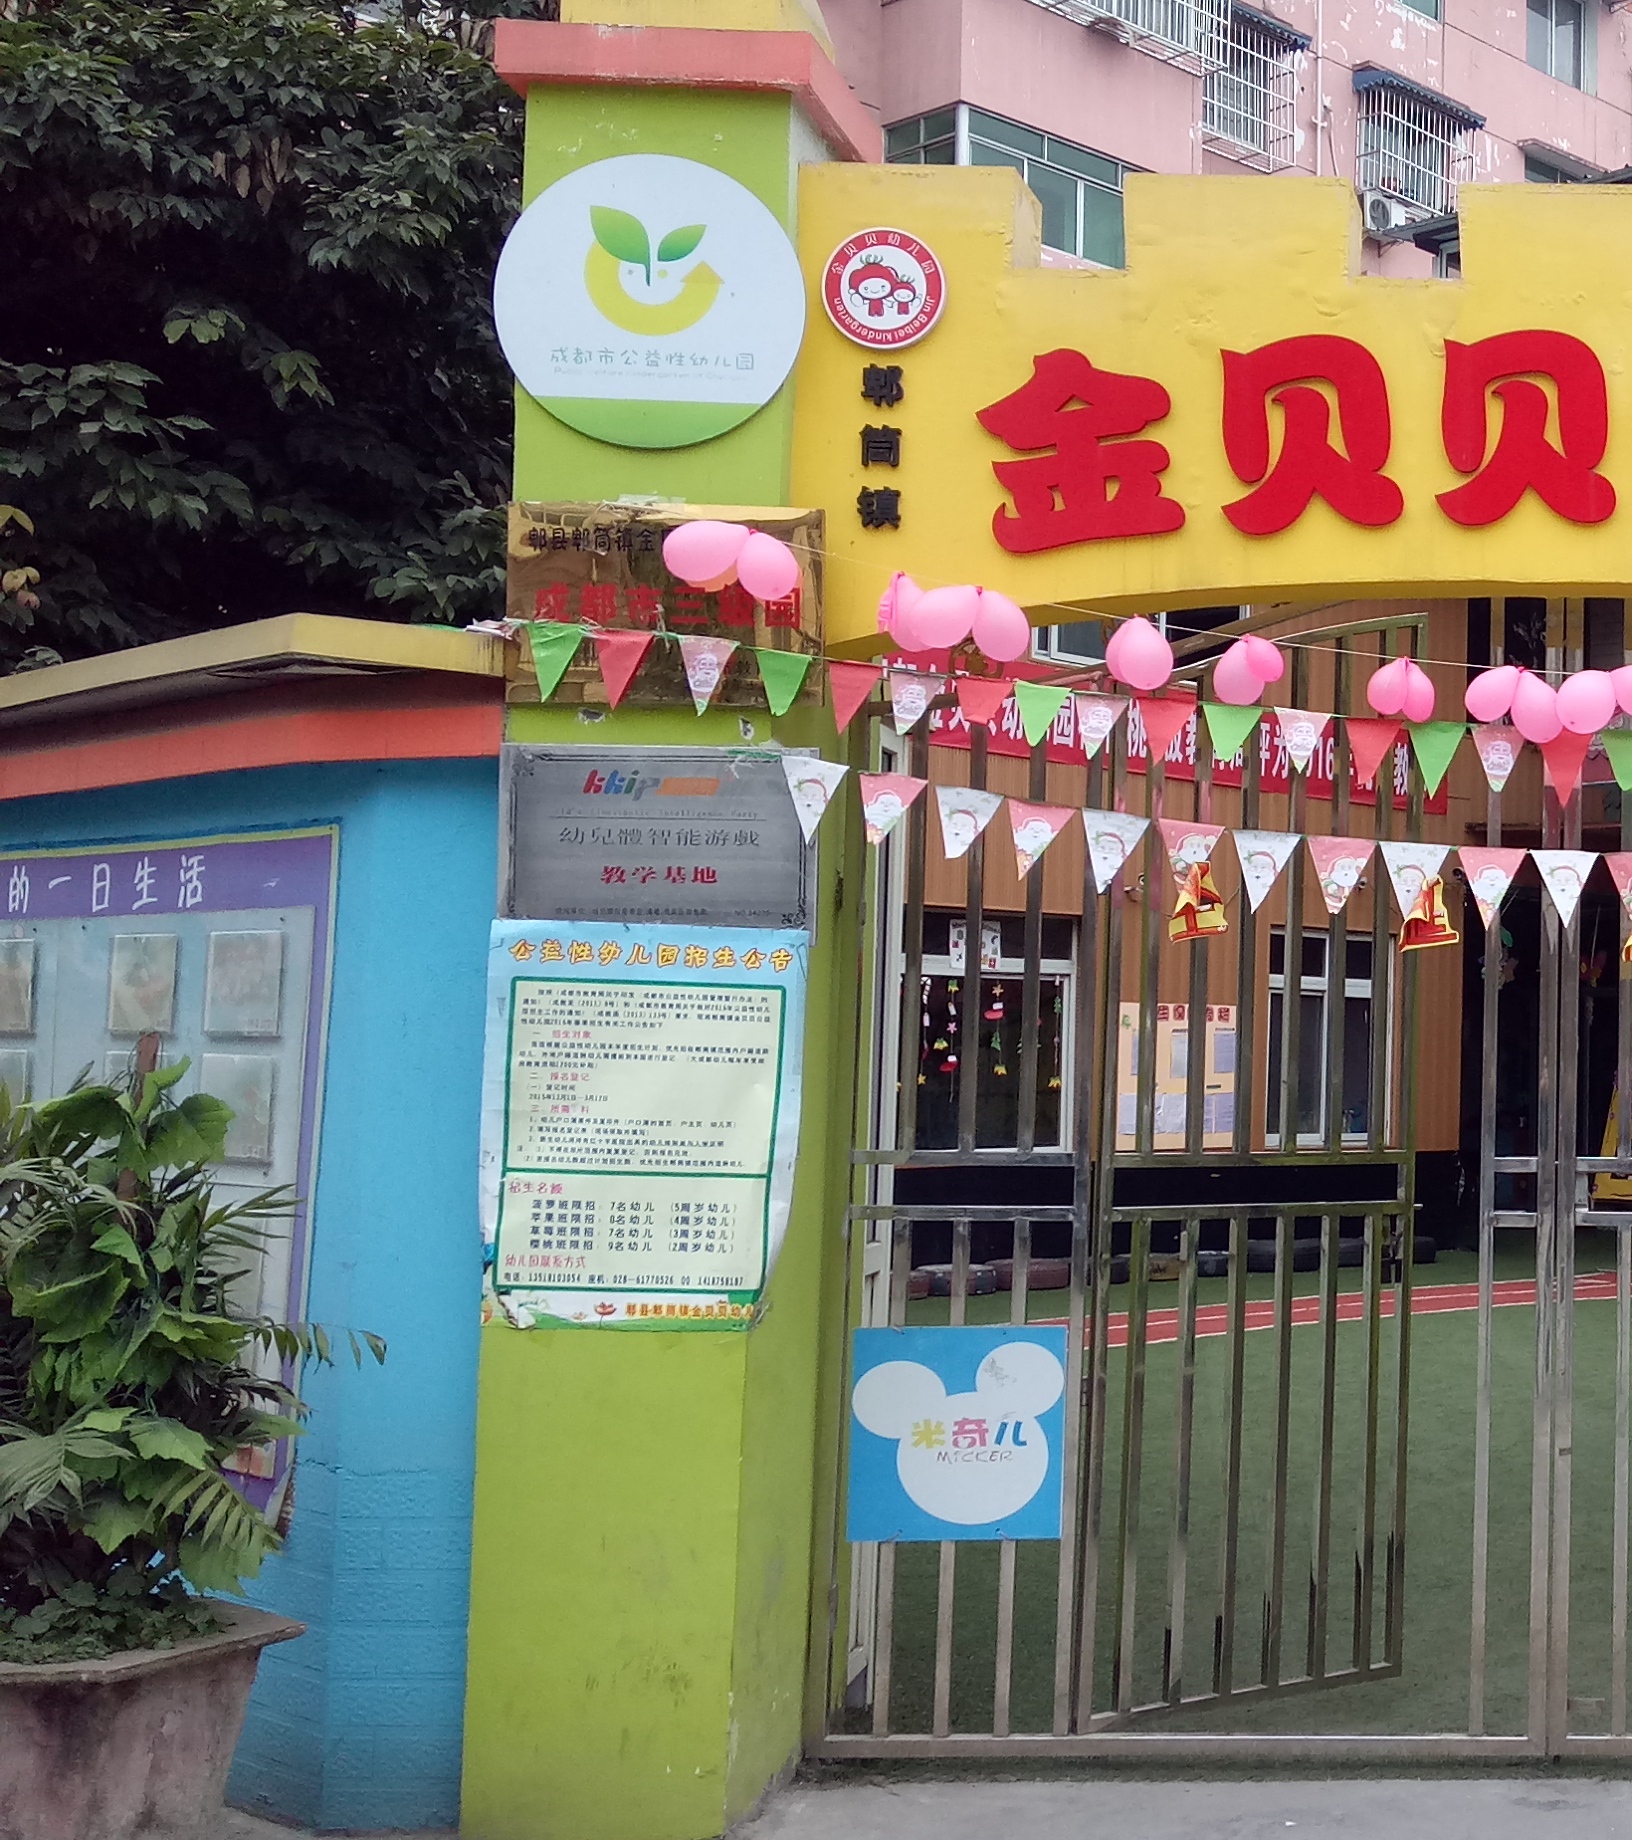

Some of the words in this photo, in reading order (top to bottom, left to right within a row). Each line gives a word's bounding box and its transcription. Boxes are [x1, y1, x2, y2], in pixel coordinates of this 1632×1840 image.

[550, 346, 755, 370] 成都市公益性幼儿园
[857, 363, 904, 530] 郫筒镇
[528, 526, 665, 552] 郫县郫筒镇金
[8, 854, 206, 914] 的一日生活
[601, 865, 719, 885] 教学基地
[509, 938, 794, 973] 公益性幼儿园招生公告
[911, 1417, 1028, 1449] 米奇儿
